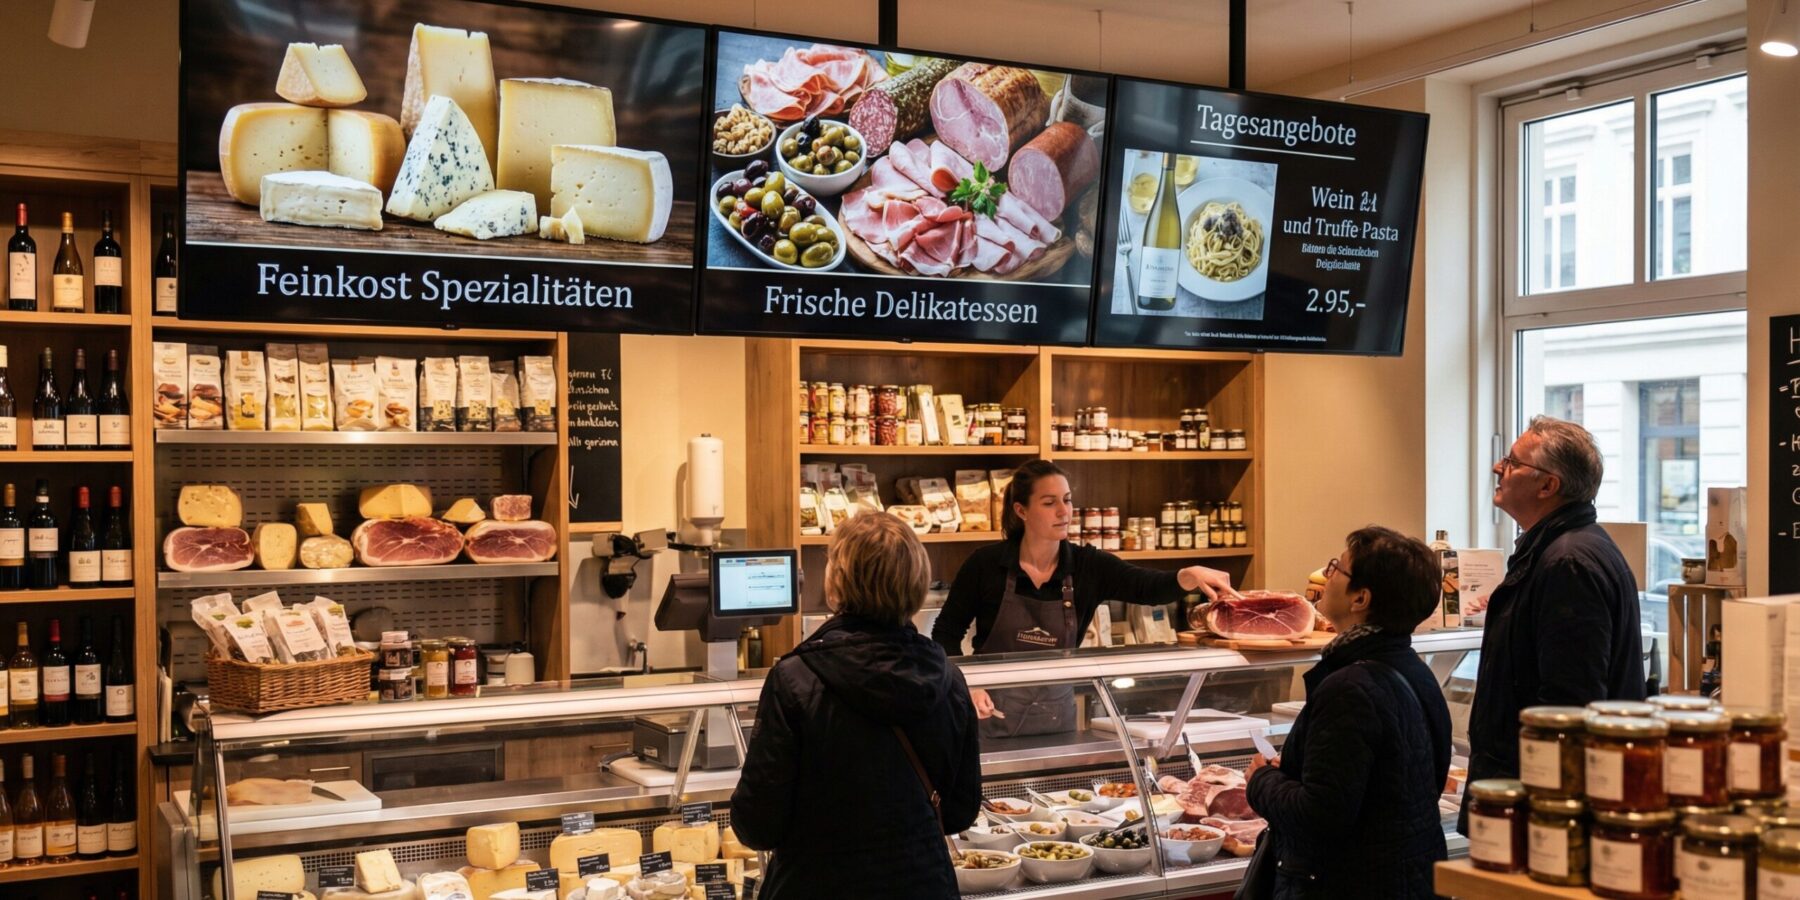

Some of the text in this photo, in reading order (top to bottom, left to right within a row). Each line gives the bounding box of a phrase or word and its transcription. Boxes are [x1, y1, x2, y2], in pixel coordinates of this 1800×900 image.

[1196, 103, 1358, 147] Tagesangebote
[1311, 186, 1354, 211] Wein
[1283, 216, 1399, 242] und Truffe Pasta
[257, 263, 634, 310] Feinkost Spezialitäten
[764, 284, 1039, 325] Frische Delikatessen
